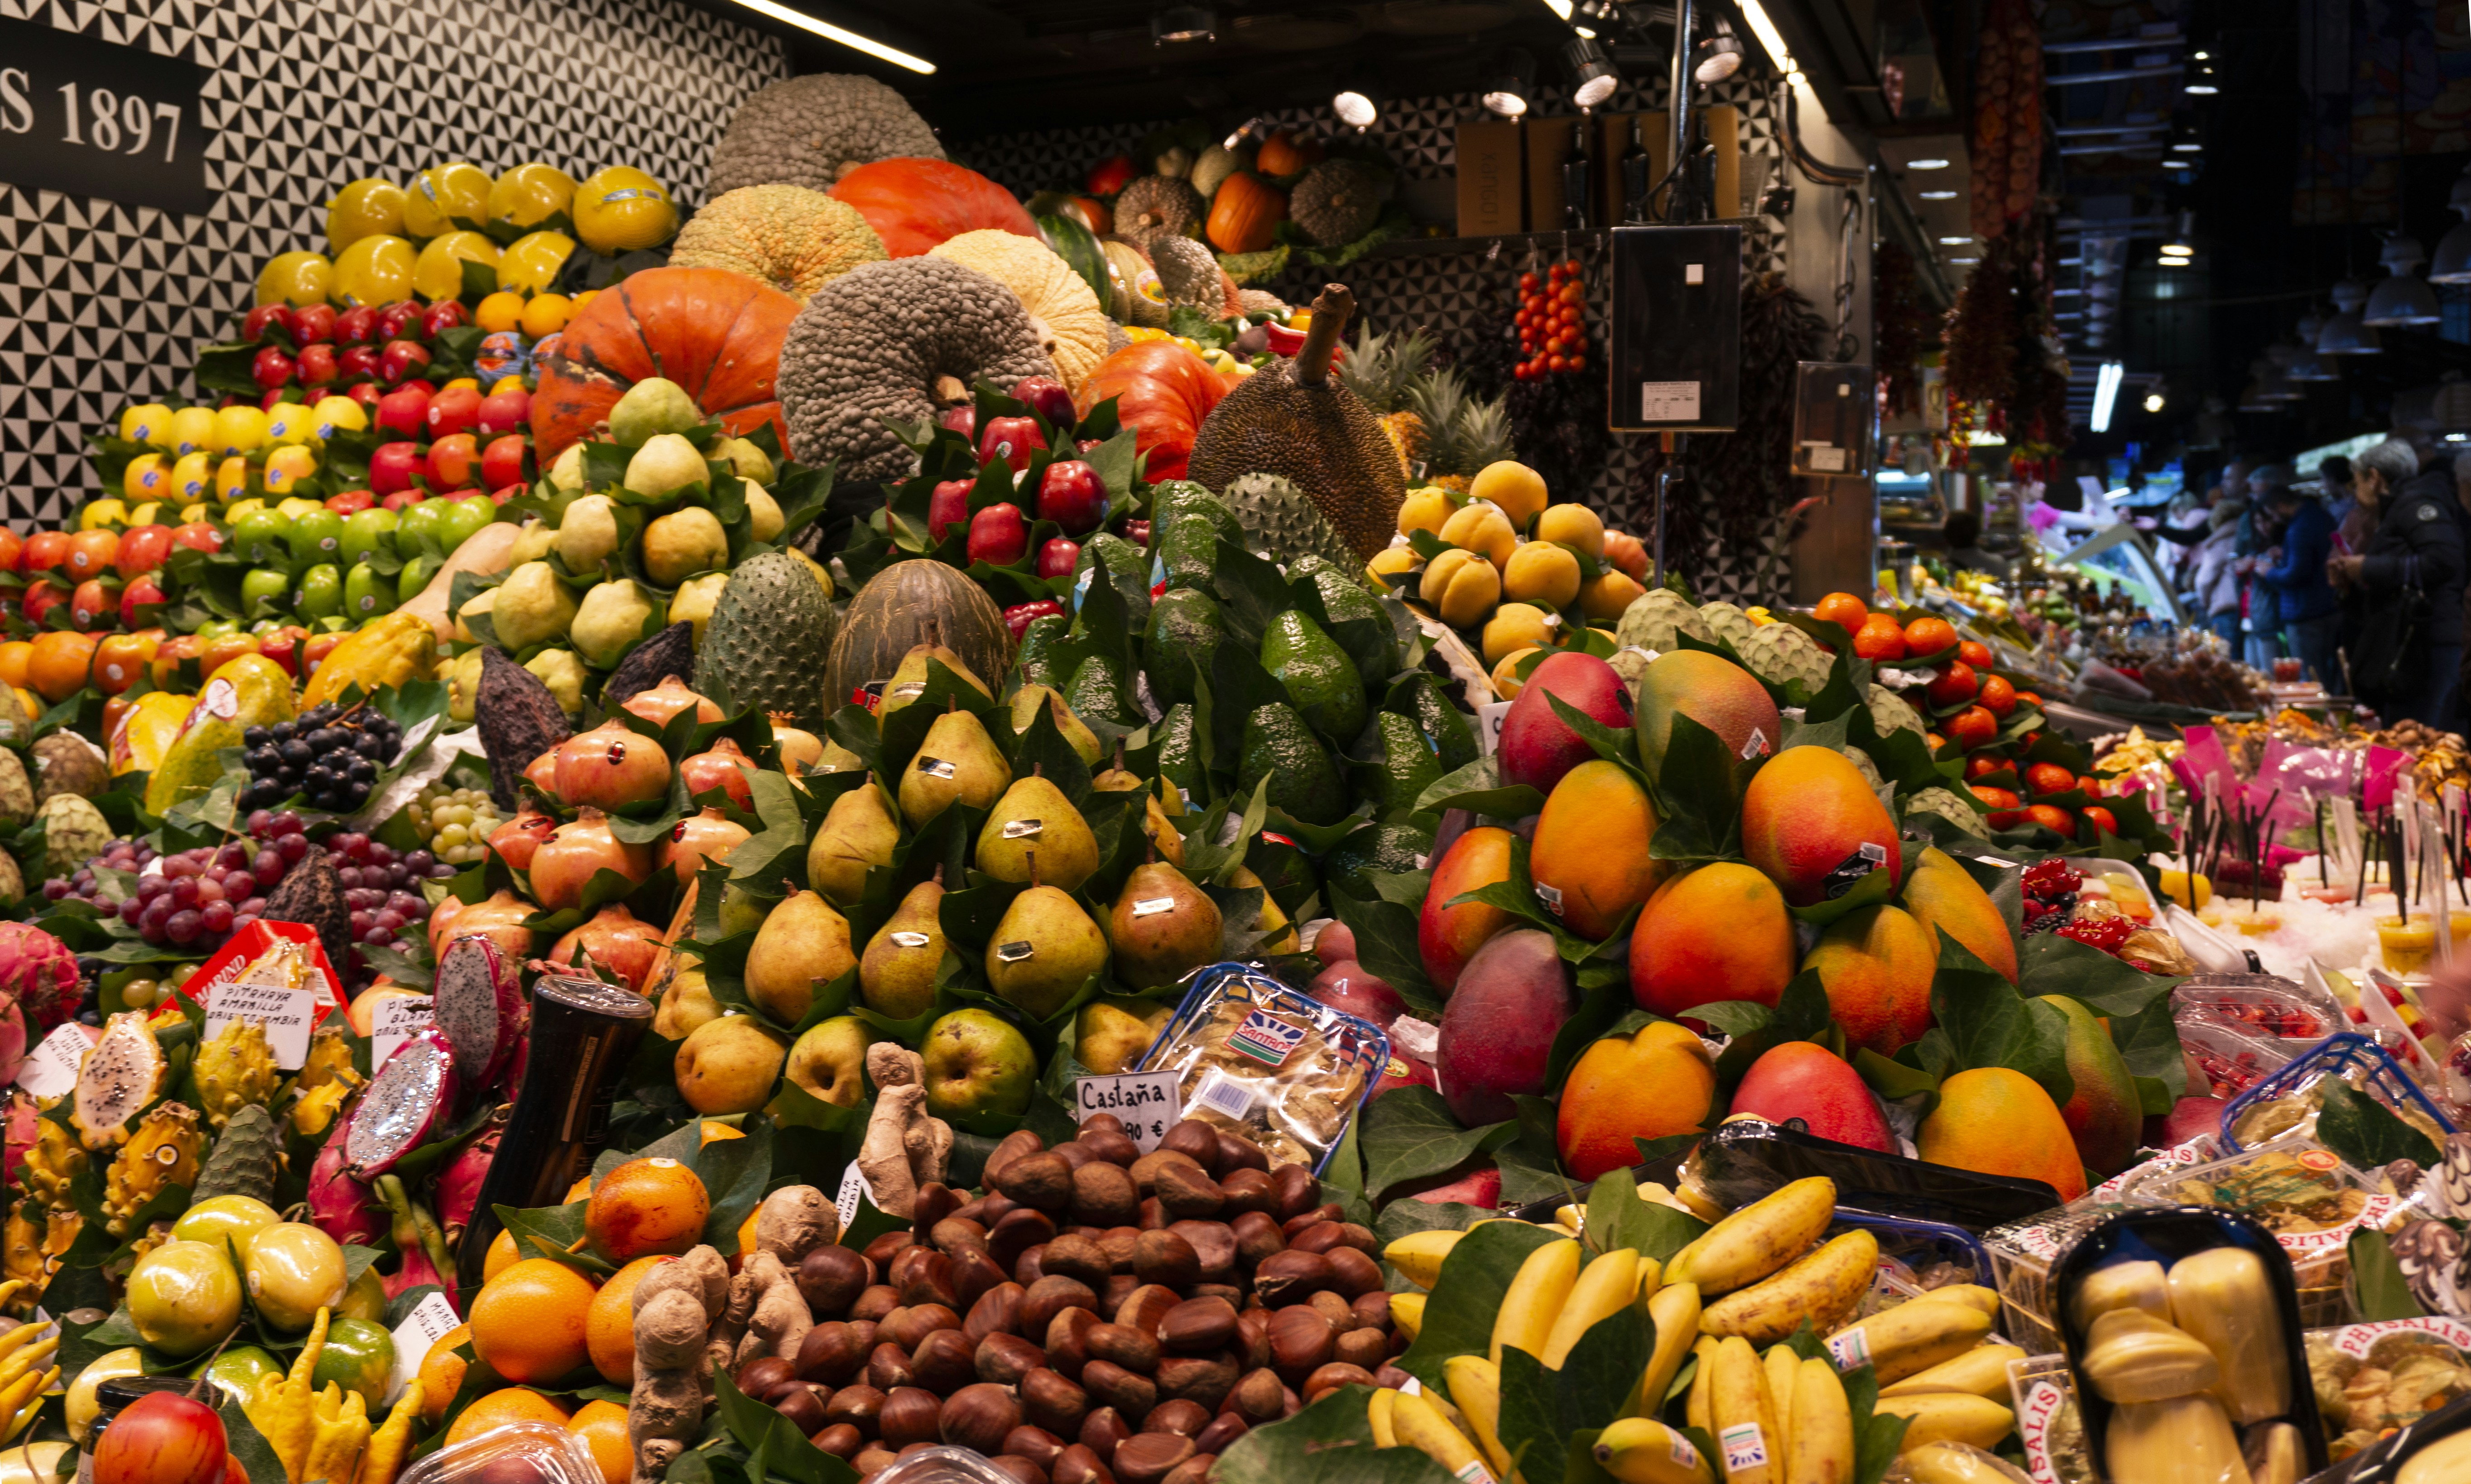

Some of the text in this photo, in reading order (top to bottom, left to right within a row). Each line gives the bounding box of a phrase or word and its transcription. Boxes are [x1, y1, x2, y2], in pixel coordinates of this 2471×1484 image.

[57, 82, 182, 163] 1897
[191, 954, 247, 1009] MARIND
[1082, 1078, 1166, 1110] Castaña
[1125, 1119, 1163, 1140] 90 €
[2099, 1148, 2193, 1202] PHLIS
[429, 1302, 457, 1331] MARAC
[2341, 1317, 2471, 1355] PHYSALIS
